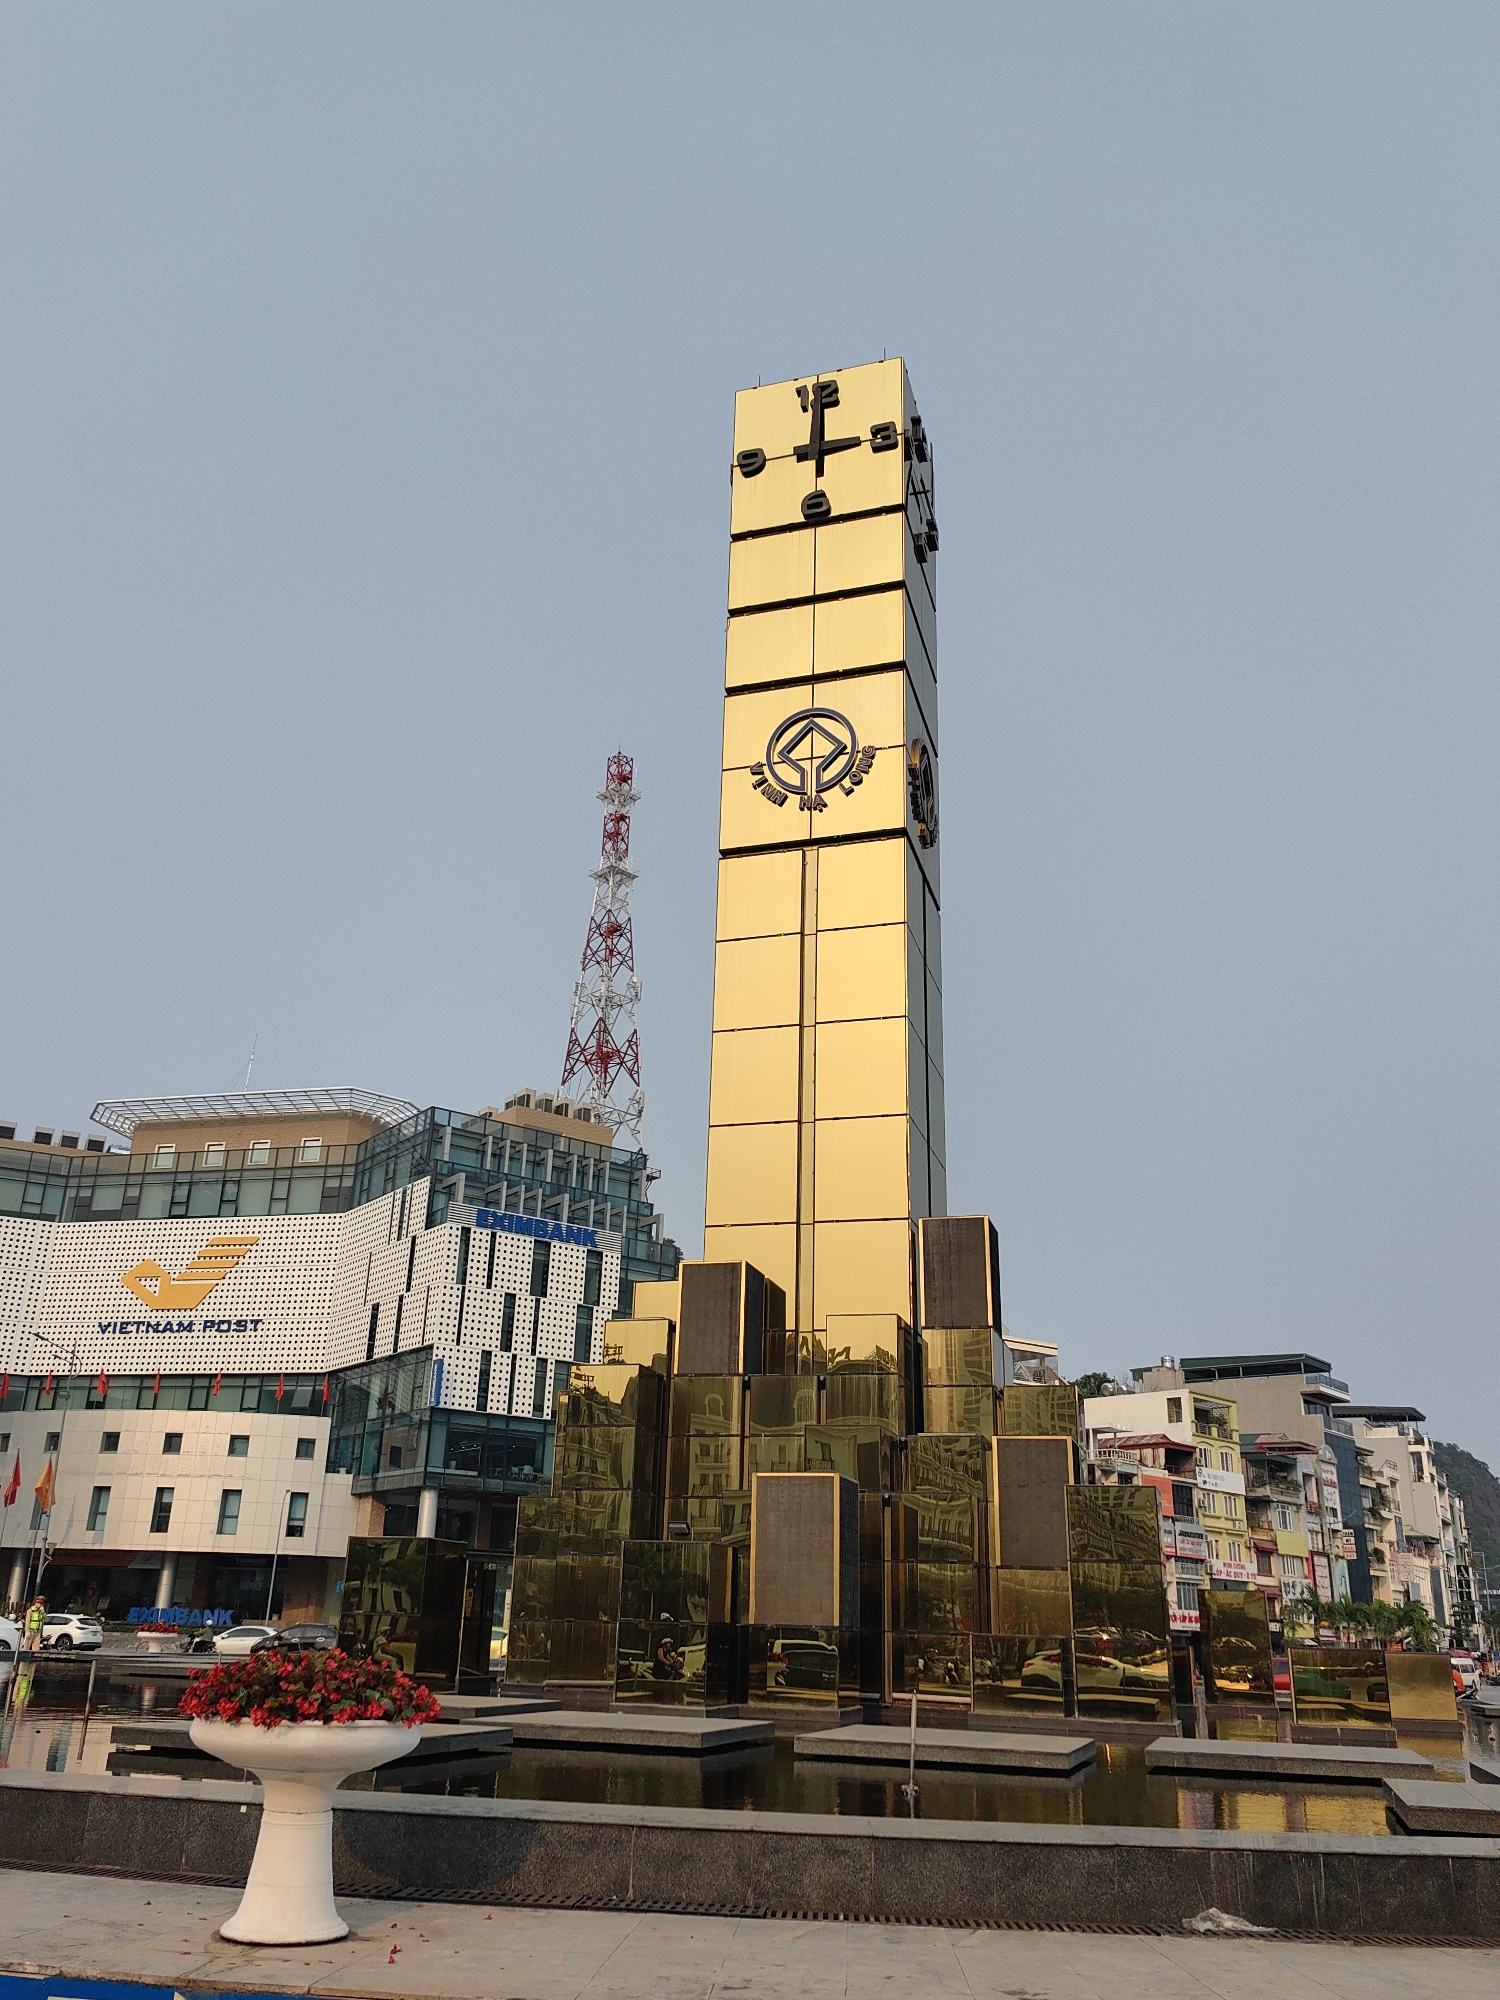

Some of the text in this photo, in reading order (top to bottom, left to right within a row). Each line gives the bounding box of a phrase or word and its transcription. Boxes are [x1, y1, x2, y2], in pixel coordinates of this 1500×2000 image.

[796, 380, 840, 413] 12
[870, 421, 898, 453] 3
[737, 448, 766, 478] 9
[801, 489, 831, 521] 6
[750, 745, 876, 813] VỊNH HẠ LONG
[476, 1208, 598, 1247] EXIMBANK
[98, 1319, 263, 1334] VIETNAM POST
[127, 1606, 234, 1626] EXIMBANK
